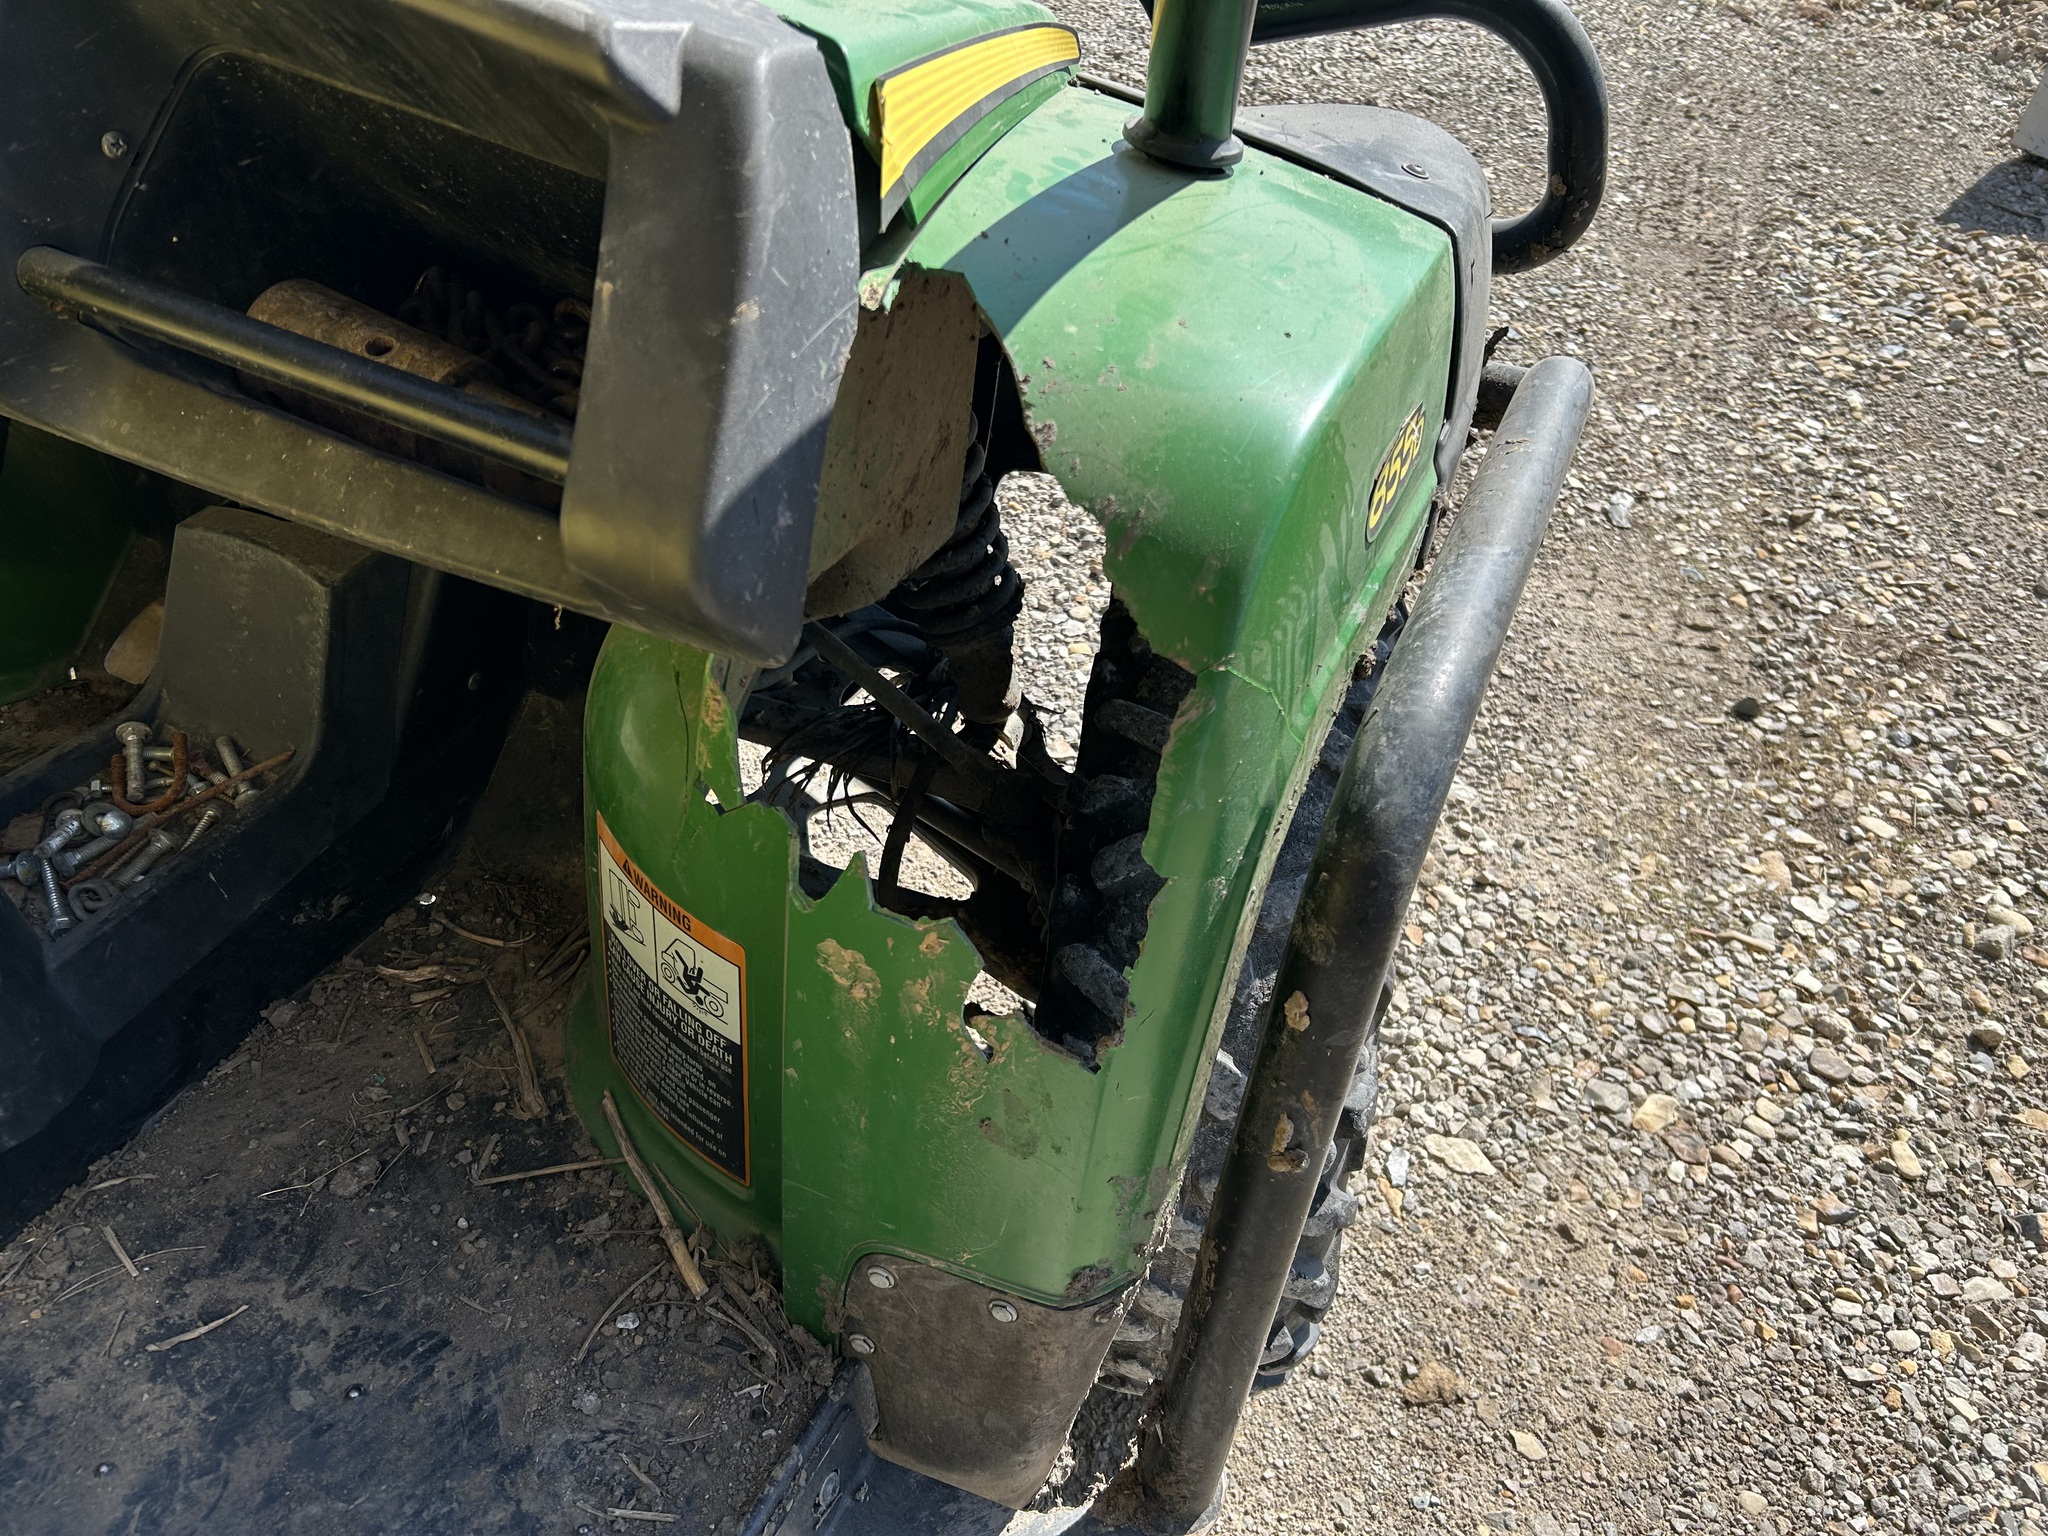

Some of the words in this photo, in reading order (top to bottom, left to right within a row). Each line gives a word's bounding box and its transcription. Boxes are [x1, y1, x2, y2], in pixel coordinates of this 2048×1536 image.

[1368, 413, 1425, 530] 855D
[633, 868, 692, 932] WARNING
[607, 936, 621, 965] CAN
[621, 957, 645, 996] CAUSE
[646, 987, 678, 1027] INJURY
[680, 1019, 694, 1040] OR
[697, 1032, 732, 1066] DEATH
[610, 930, 646, 986] ROLLOVER
[647, 978, 660, 1000] OR
[662, 993, 702, 1035] FALLING
[705, 1026, 726, 1051] OFF
[651, 1006, 677, 1036] operator's
[677, 1030, 698, 1053] manual
[699, 1046, 719, 1068] before
[720, 1061, 734, 1077] use.
[658, 1029, 669, 1045] and
[669, 1040, 686, 1061] sharp
[686, 1054, 705, 1074] turns.
[666, 1045, 682, 1064] when
[707, 1078, 716, 1090] on
[666, 1060, 684, 1083] slope.
[684, 1075, 708, 1100] Vehicle
[708, 1094, 721, 1109] can
[674, 1060, 690, 1080] night
[706, 1084, 733, 1109] reverse.
[660, 1078, 678, 1101] during
[678, 1095, 692, 1112] use.
[660, 1085, 676, 1106] under
[676, 1099, 686, 1114] the
[686, 1108, 715, 1136] influence
[665, 1075, 675, 1090] and
[676, 1086, 687, 1100] one
[688, 1095, 722, 1126] passenger.
[670, 1108, 694, 1137] intended
[695, 1130, 704, 1144] for
[705, 1138, 717, 1153] use
[717, 1147, 727, 1159] on
